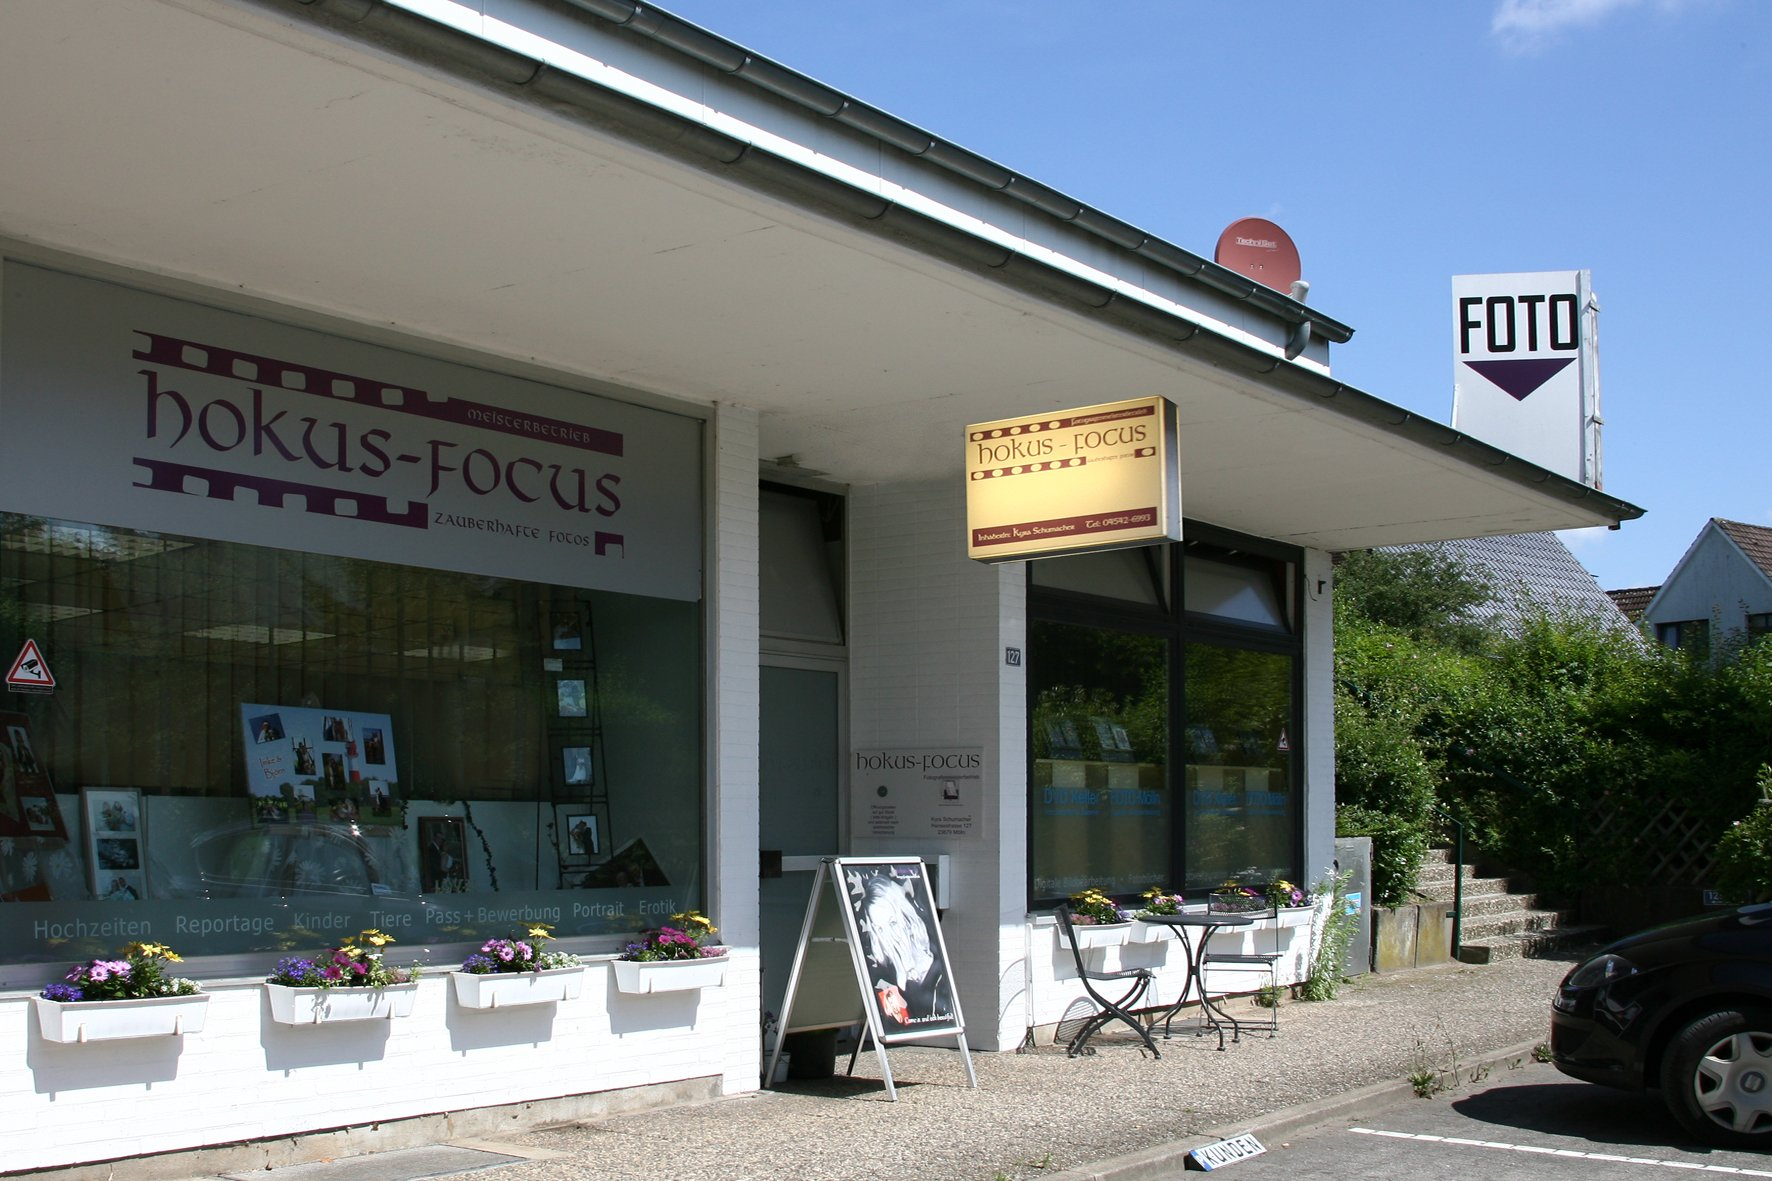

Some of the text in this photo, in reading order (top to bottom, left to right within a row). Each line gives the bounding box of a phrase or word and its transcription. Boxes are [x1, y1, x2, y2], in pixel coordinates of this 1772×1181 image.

[1459, 293, 1579, 354] FOTO
[1007, 649, 1020, 664] 127
[33, 918, 151, 939] Hochzeiten
[175, 914, 275, 936] Reportage
[294, 912, 352, 930] Kinder
[369, 910, 412, 928] Tiere
[425, 907, 461, 924] Pass
[477, 904, 560, 923] Bewerbung
[573, 902, 625, 918] Portrait
[639, 899, 677, 916] Erotik
[1200, 1136, 1263, 1165] KUNDEN
